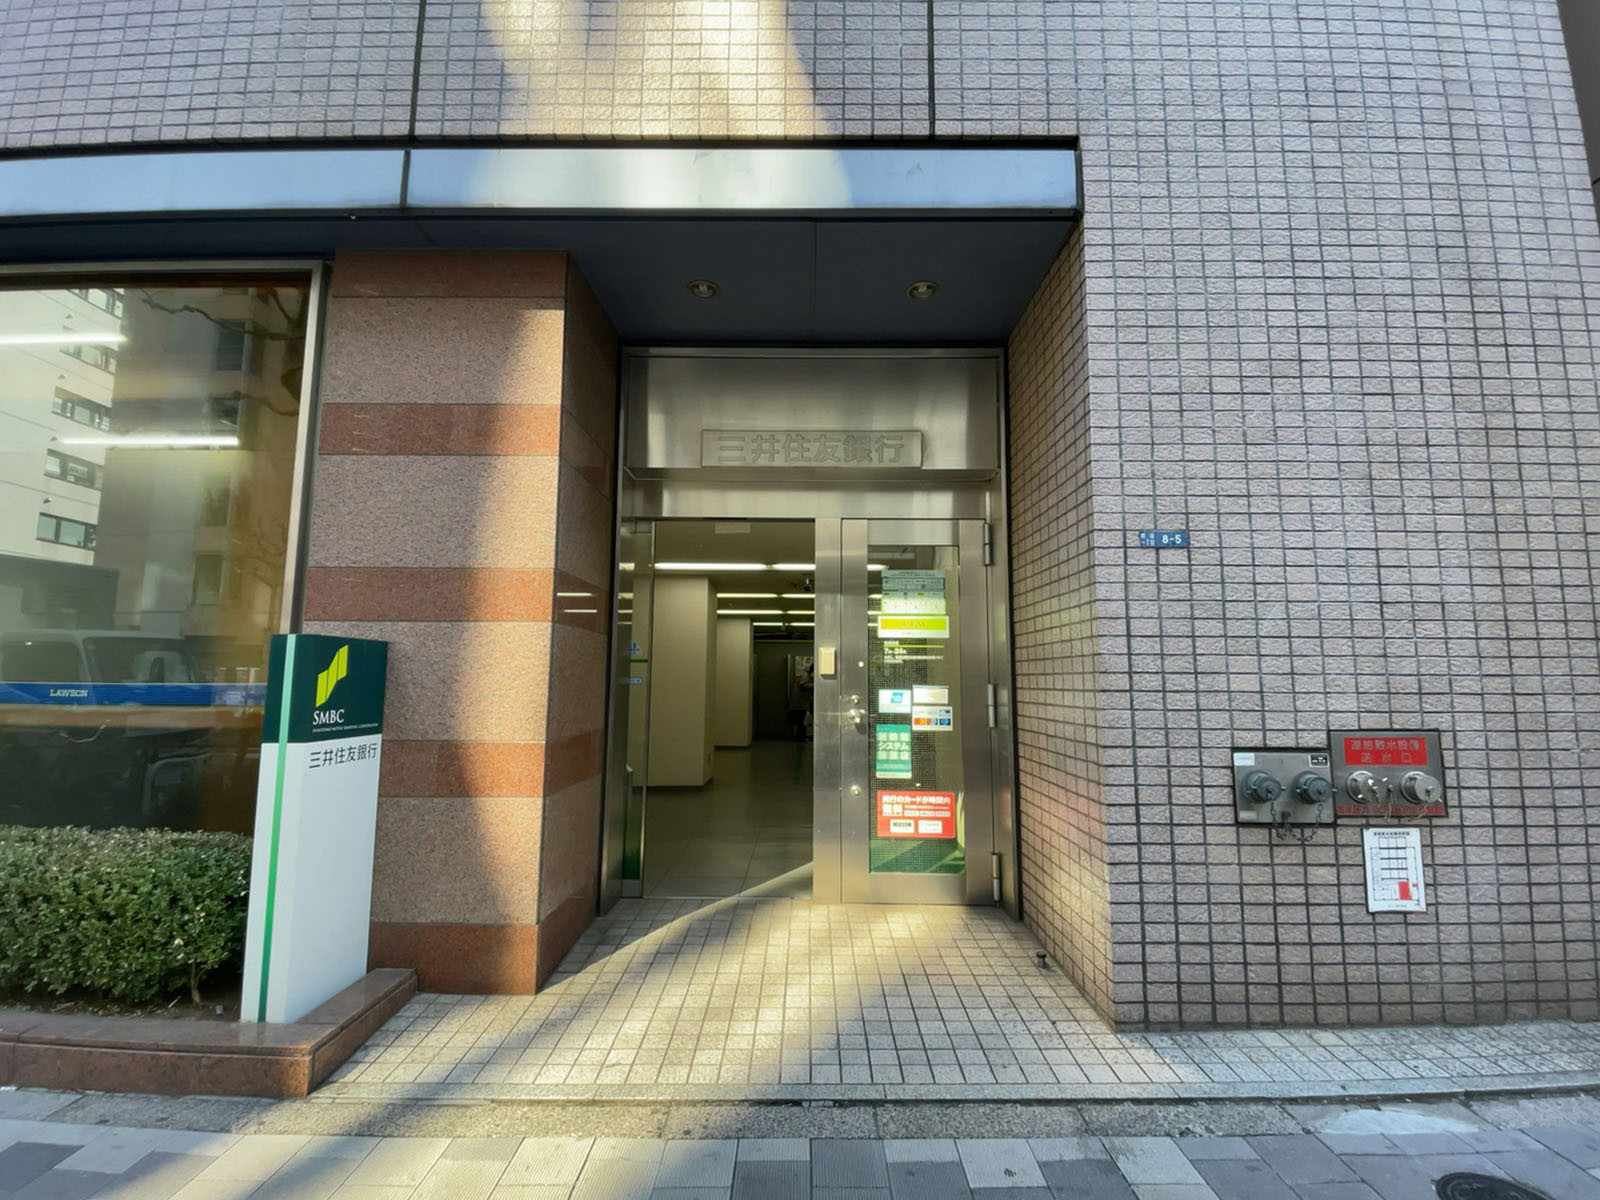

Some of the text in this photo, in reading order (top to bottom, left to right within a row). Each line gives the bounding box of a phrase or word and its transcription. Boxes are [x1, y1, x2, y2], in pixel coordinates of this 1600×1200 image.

[717, 433, 905, 463] 三井住友銀行
[1161, 534, 1182, 545] 8-5
[312, 709, 345, 725] SMBC
[309, 743, 377, 769] 三井住友銀行
